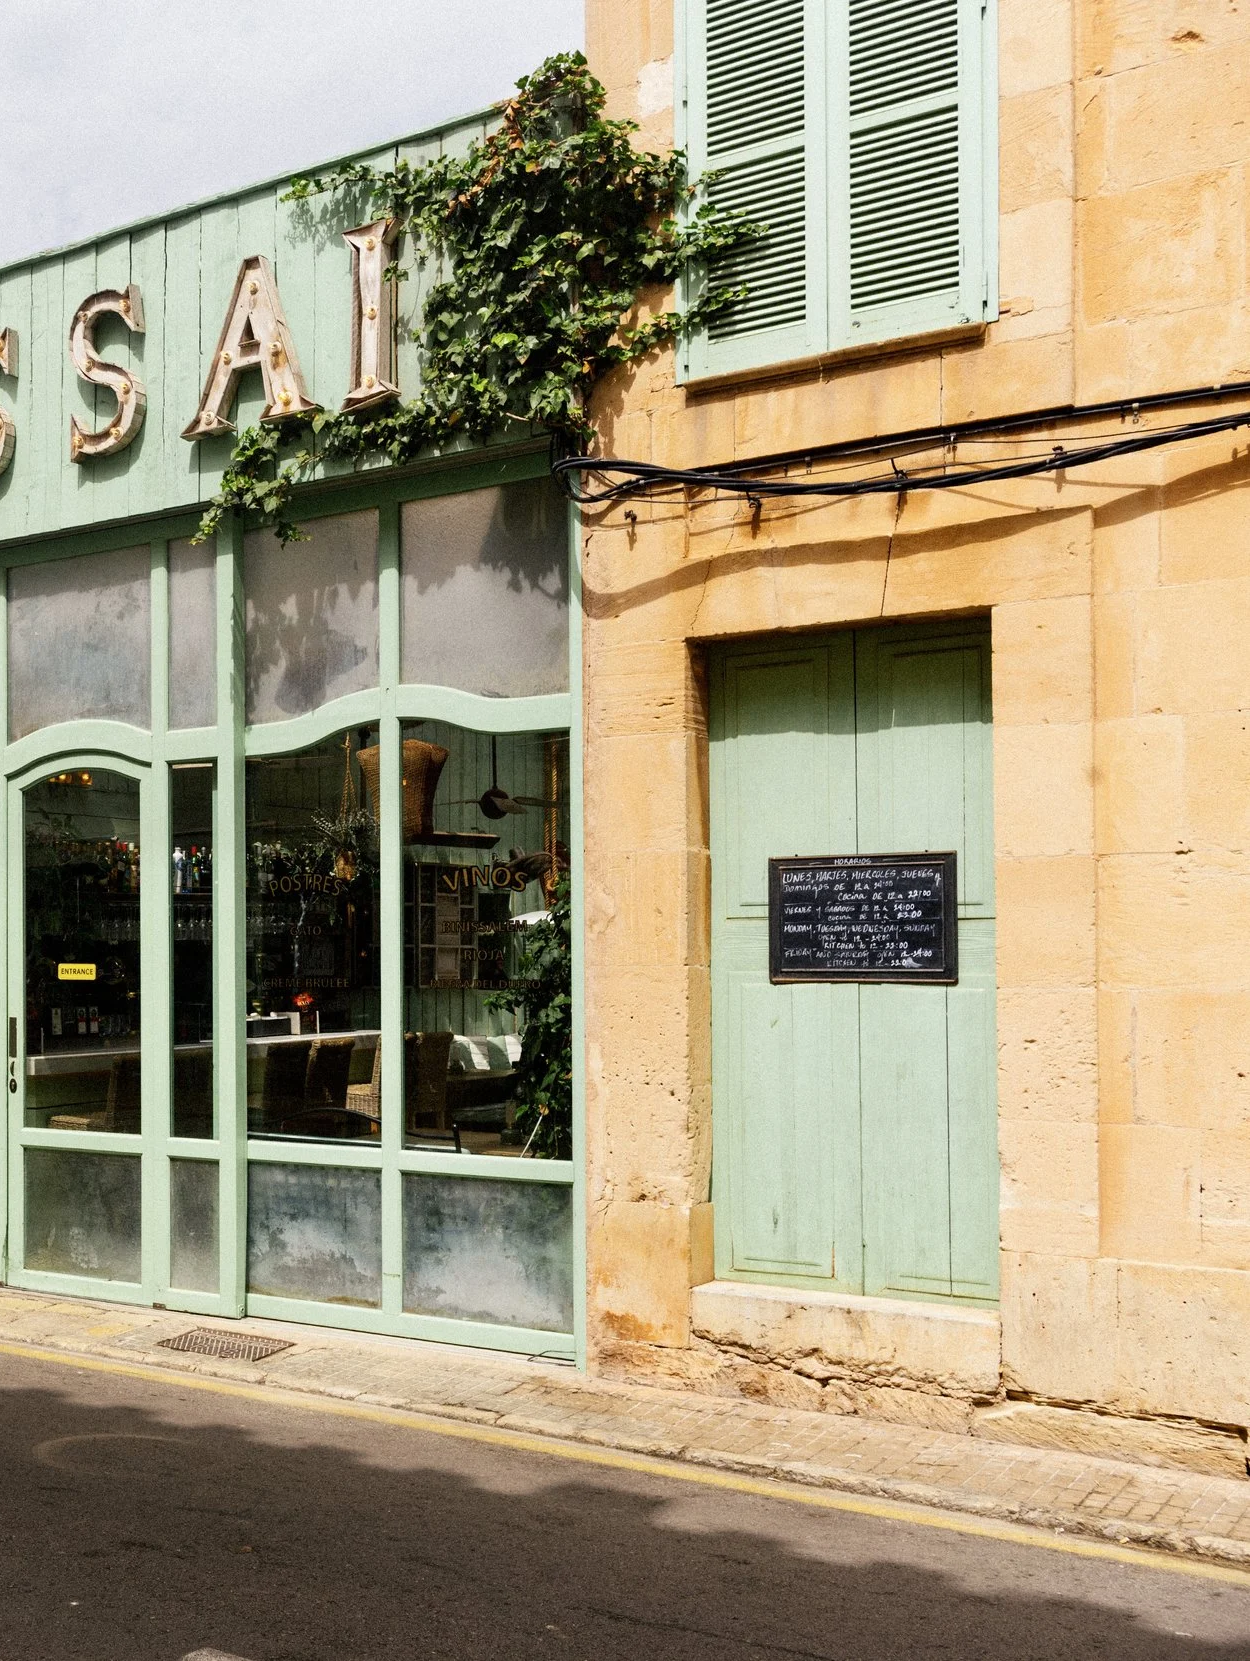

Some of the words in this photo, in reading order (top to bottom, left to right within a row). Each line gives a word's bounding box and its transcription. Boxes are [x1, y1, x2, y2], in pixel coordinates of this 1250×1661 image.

[834, 858, 872, 866] HORARIOS
[441, 864, 529, 892] VINOS
[269, 873, 343, 897] POSTRES
[290, 926, 322, 936] GATO
[441, 920, 529, 933] BINISSALEM
[464, 949, 505, 961] RIOJA
[60, 967, 94, 976] ENTRANCE
